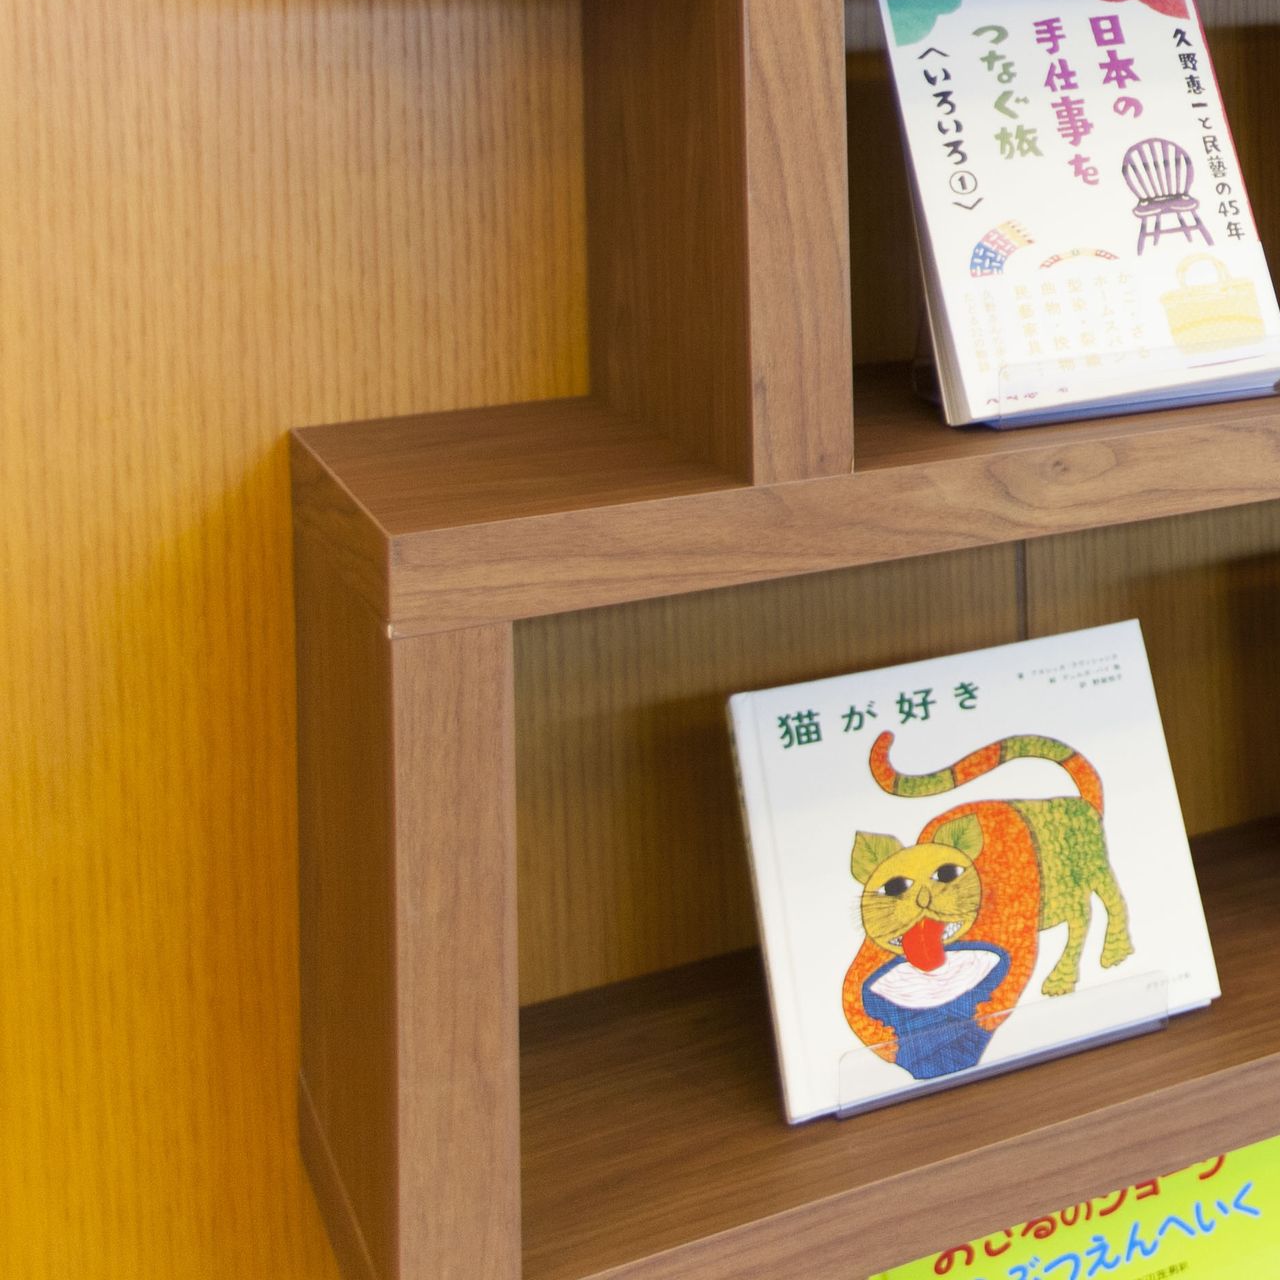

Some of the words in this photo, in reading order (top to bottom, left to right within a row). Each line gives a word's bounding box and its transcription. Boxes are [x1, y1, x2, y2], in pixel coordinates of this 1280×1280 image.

[972, 24, 1045, 160] つなぐ旅
[1032, 16, 1100, 187] 手仕事を
[1088, 14, 1144, 119] 日本の
[777, 681, 981, 750] 猫が好き
